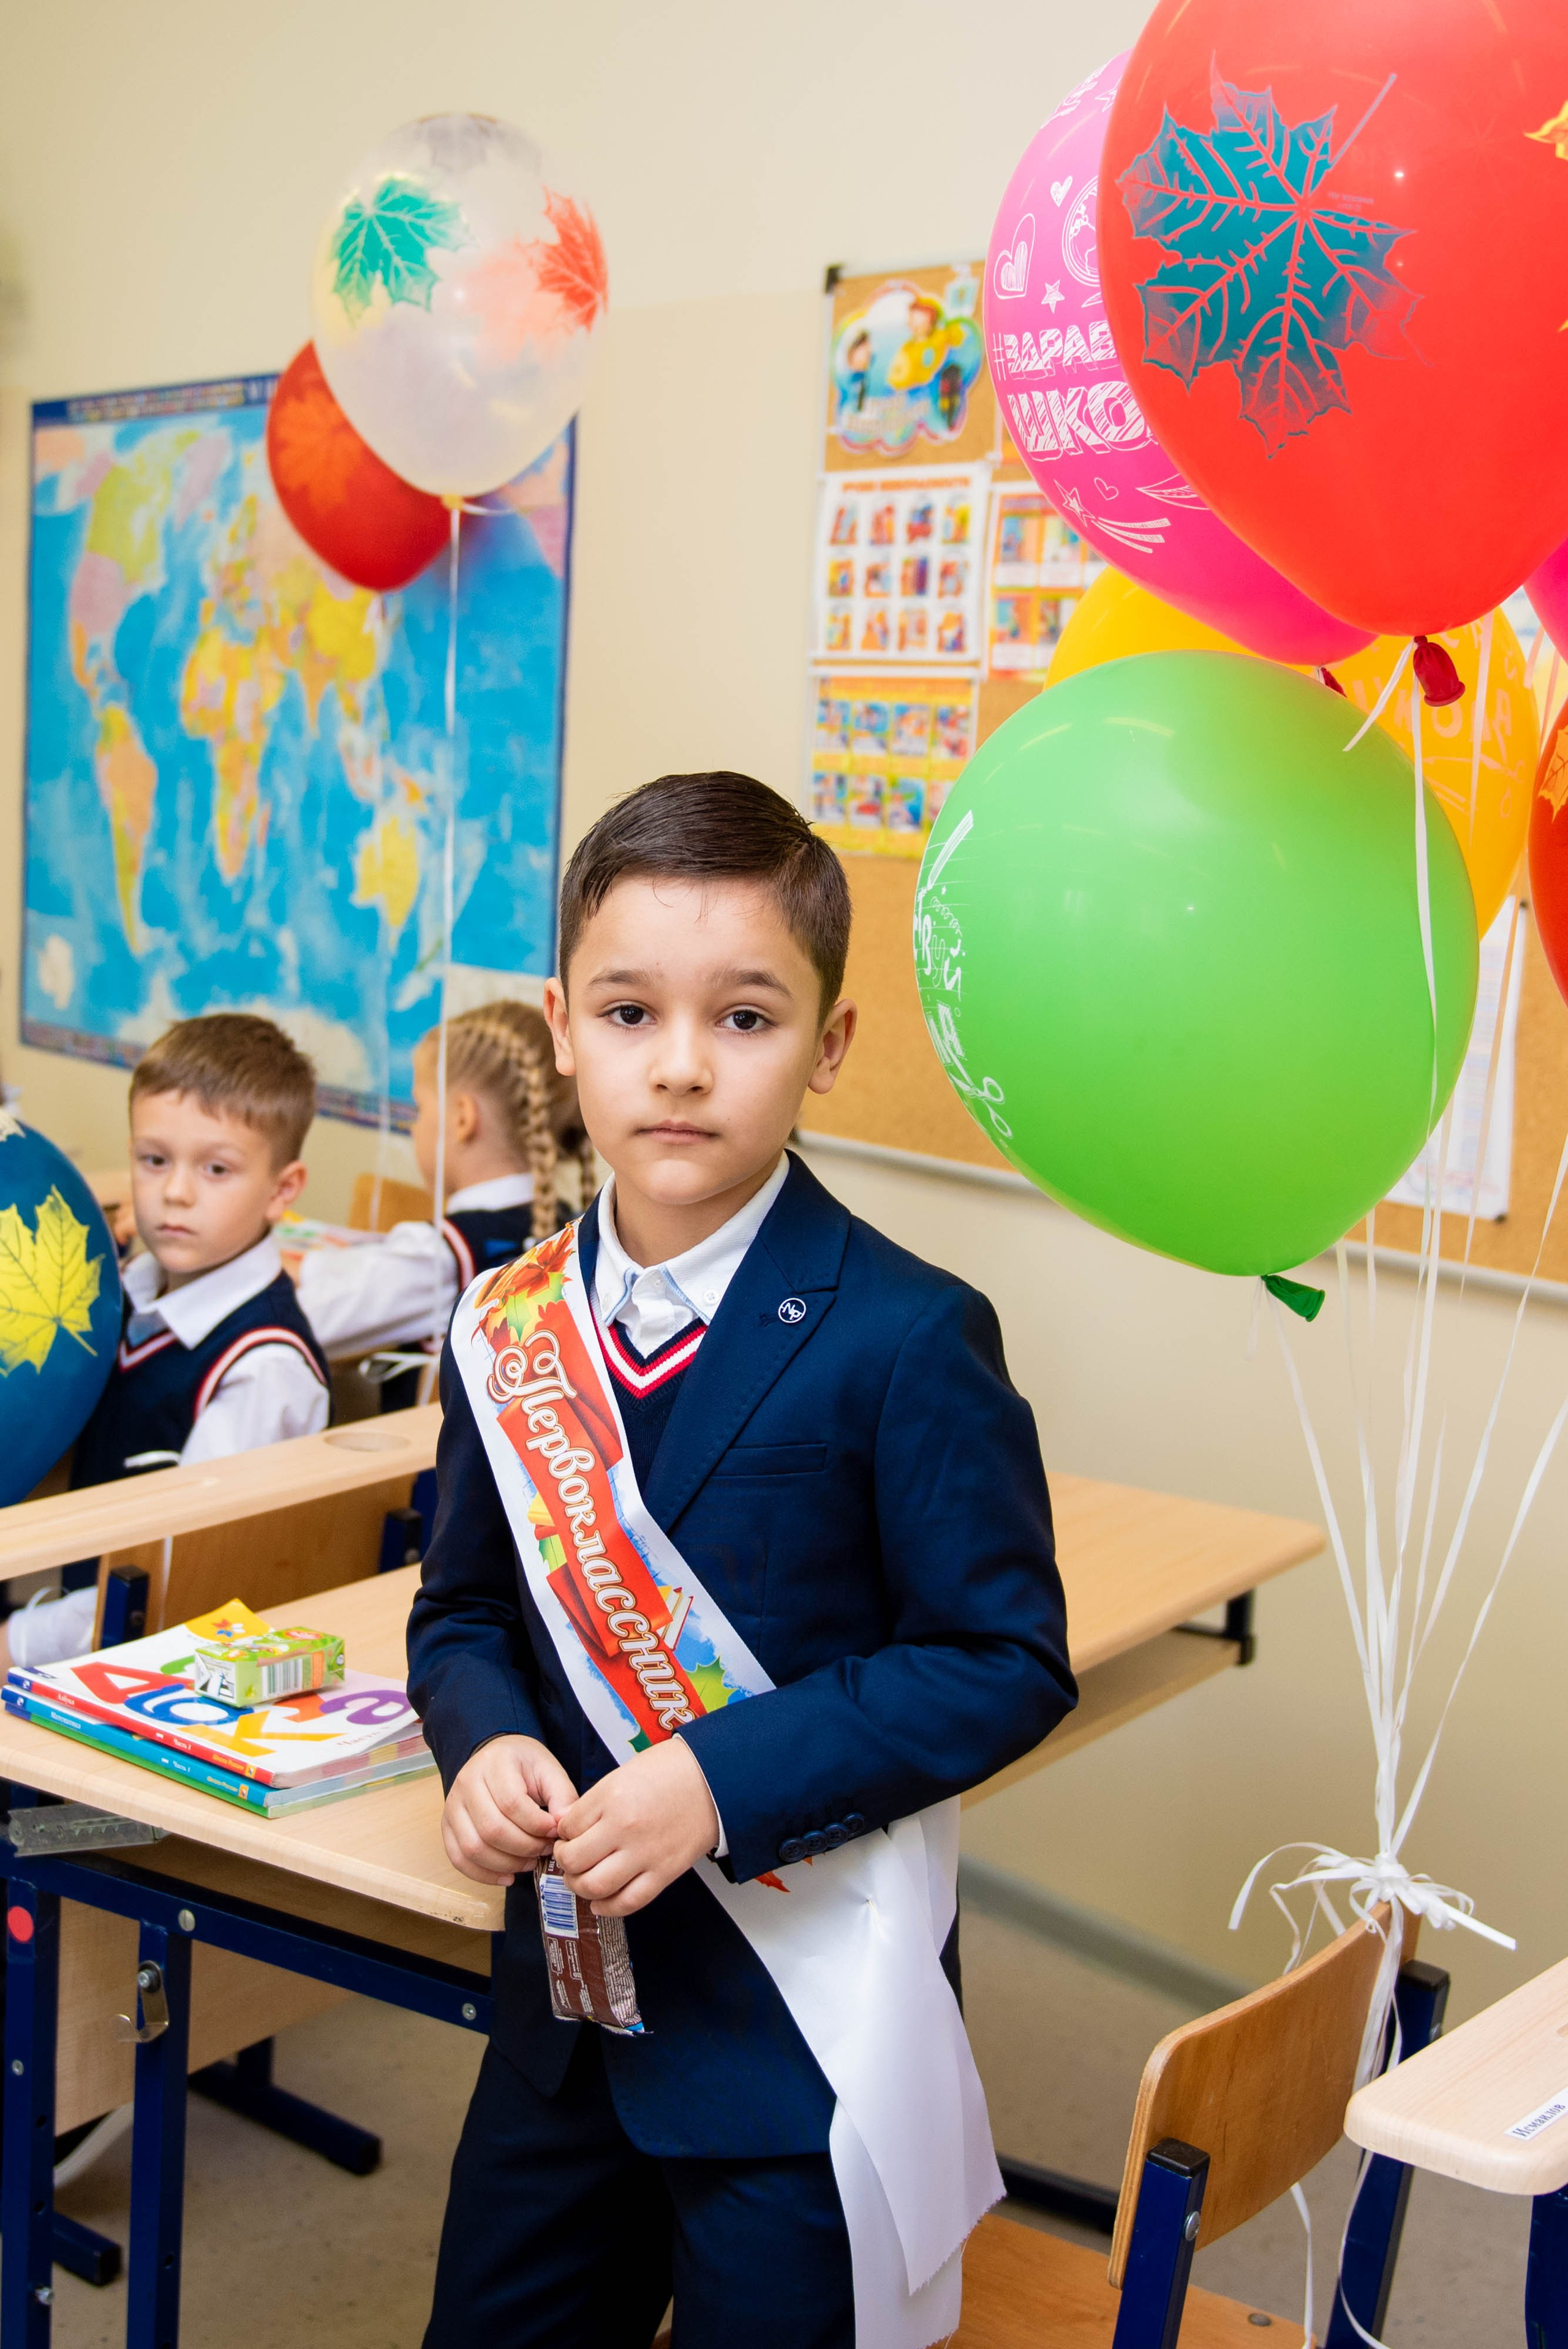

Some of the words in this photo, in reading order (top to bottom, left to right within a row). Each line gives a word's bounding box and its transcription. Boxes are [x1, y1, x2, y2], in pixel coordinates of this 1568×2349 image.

[1007, 380, 1158, 462] ШКО
[487, 1329, 696, 1730] Первоклассник
[1512, 2103, 1566, 2137] Исмаилов
